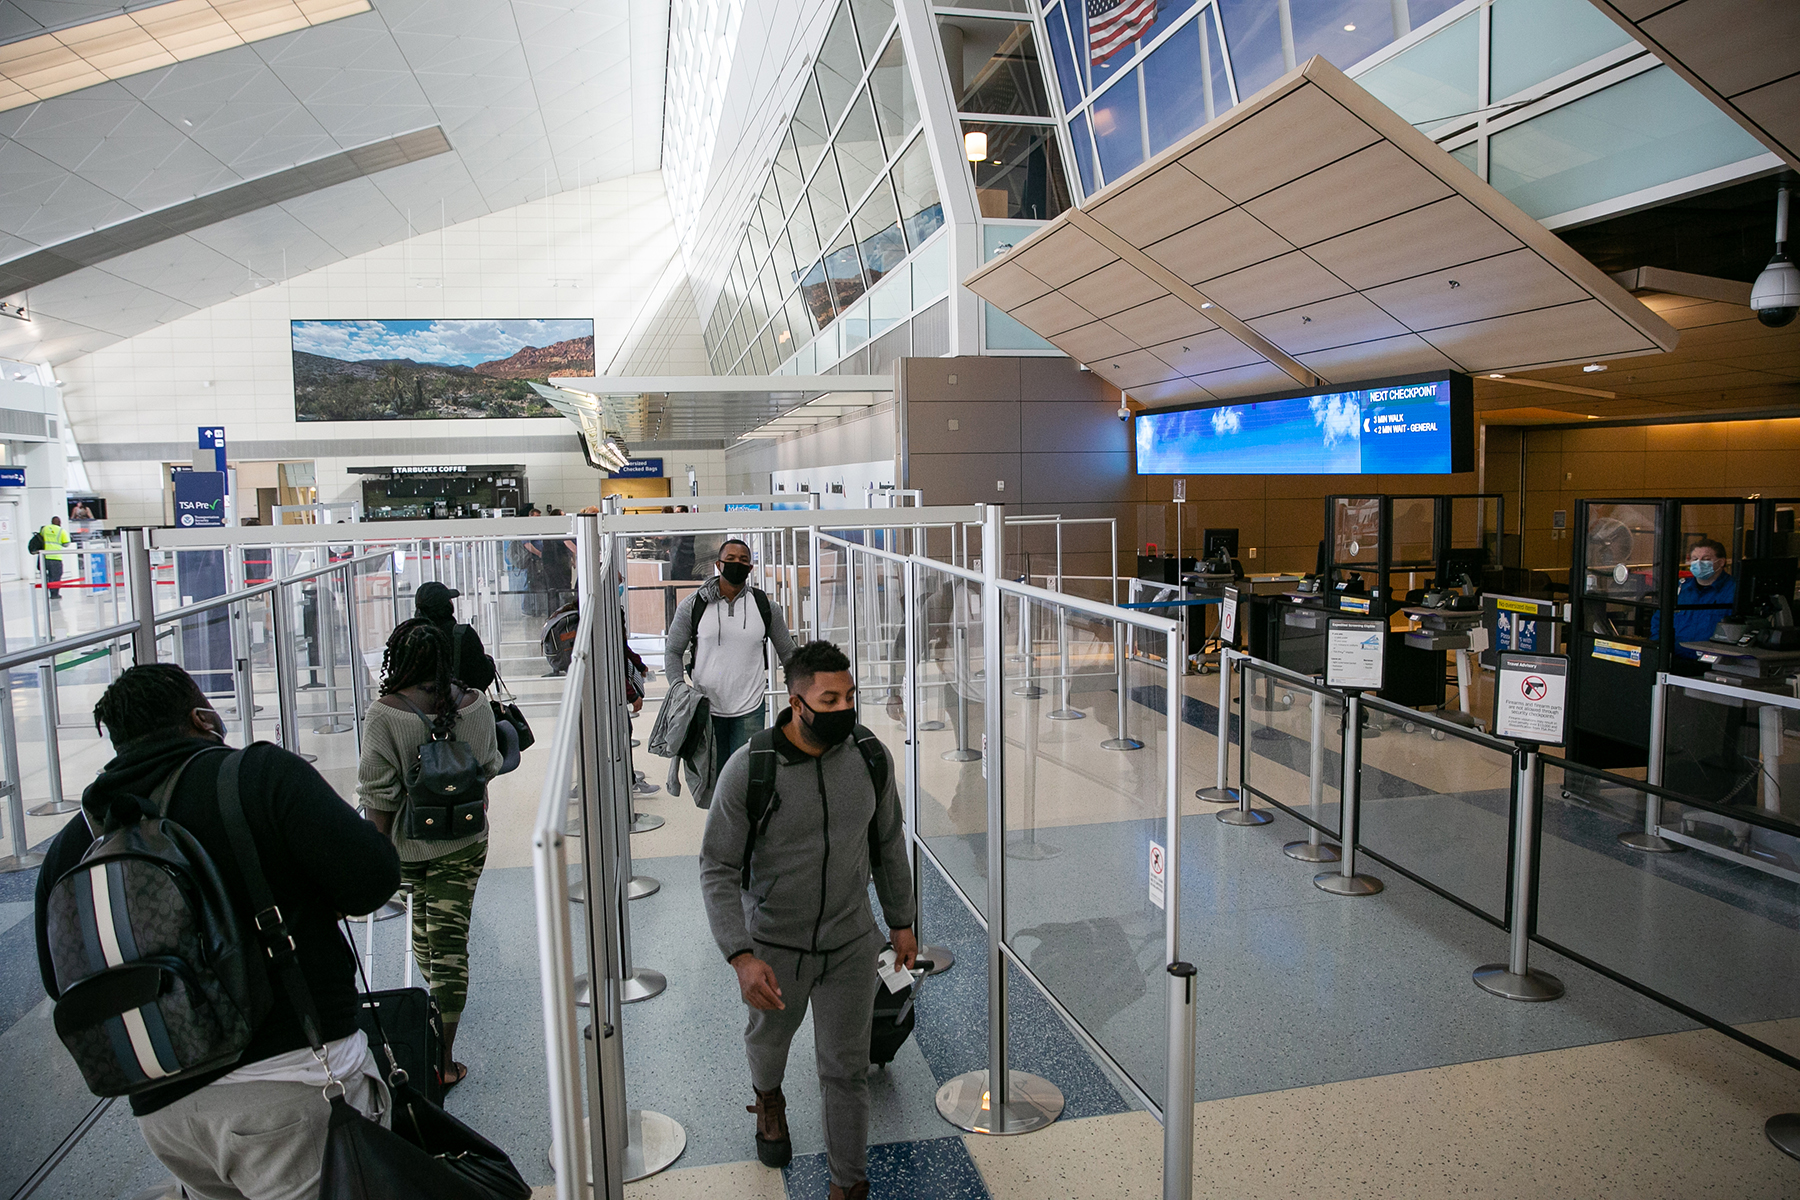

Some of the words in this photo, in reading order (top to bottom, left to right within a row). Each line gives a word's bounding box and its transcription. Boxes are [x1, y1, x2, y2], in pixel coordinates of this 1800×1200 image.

[1370, 391, 1389, 402] NEXT
[1389, 385, 1437, 400] CHECKPOINT
[1373, 416, 1378, 424] 3
[1378, 415, 1388, 424] MIN
[1388, 414, 1404, 423] WALK
[1382, 425, 1393, 434] MIN
[1393, 424, 1407, 433] WAIT
[1410, 422, 1438, 432] GENERAL
[438, 465, 467, 473] COFFEE
[179, 501, 195, 509] TSA
[1505, 602, 1525, 610] oversized
[1525, 604, 1537, 612] items
